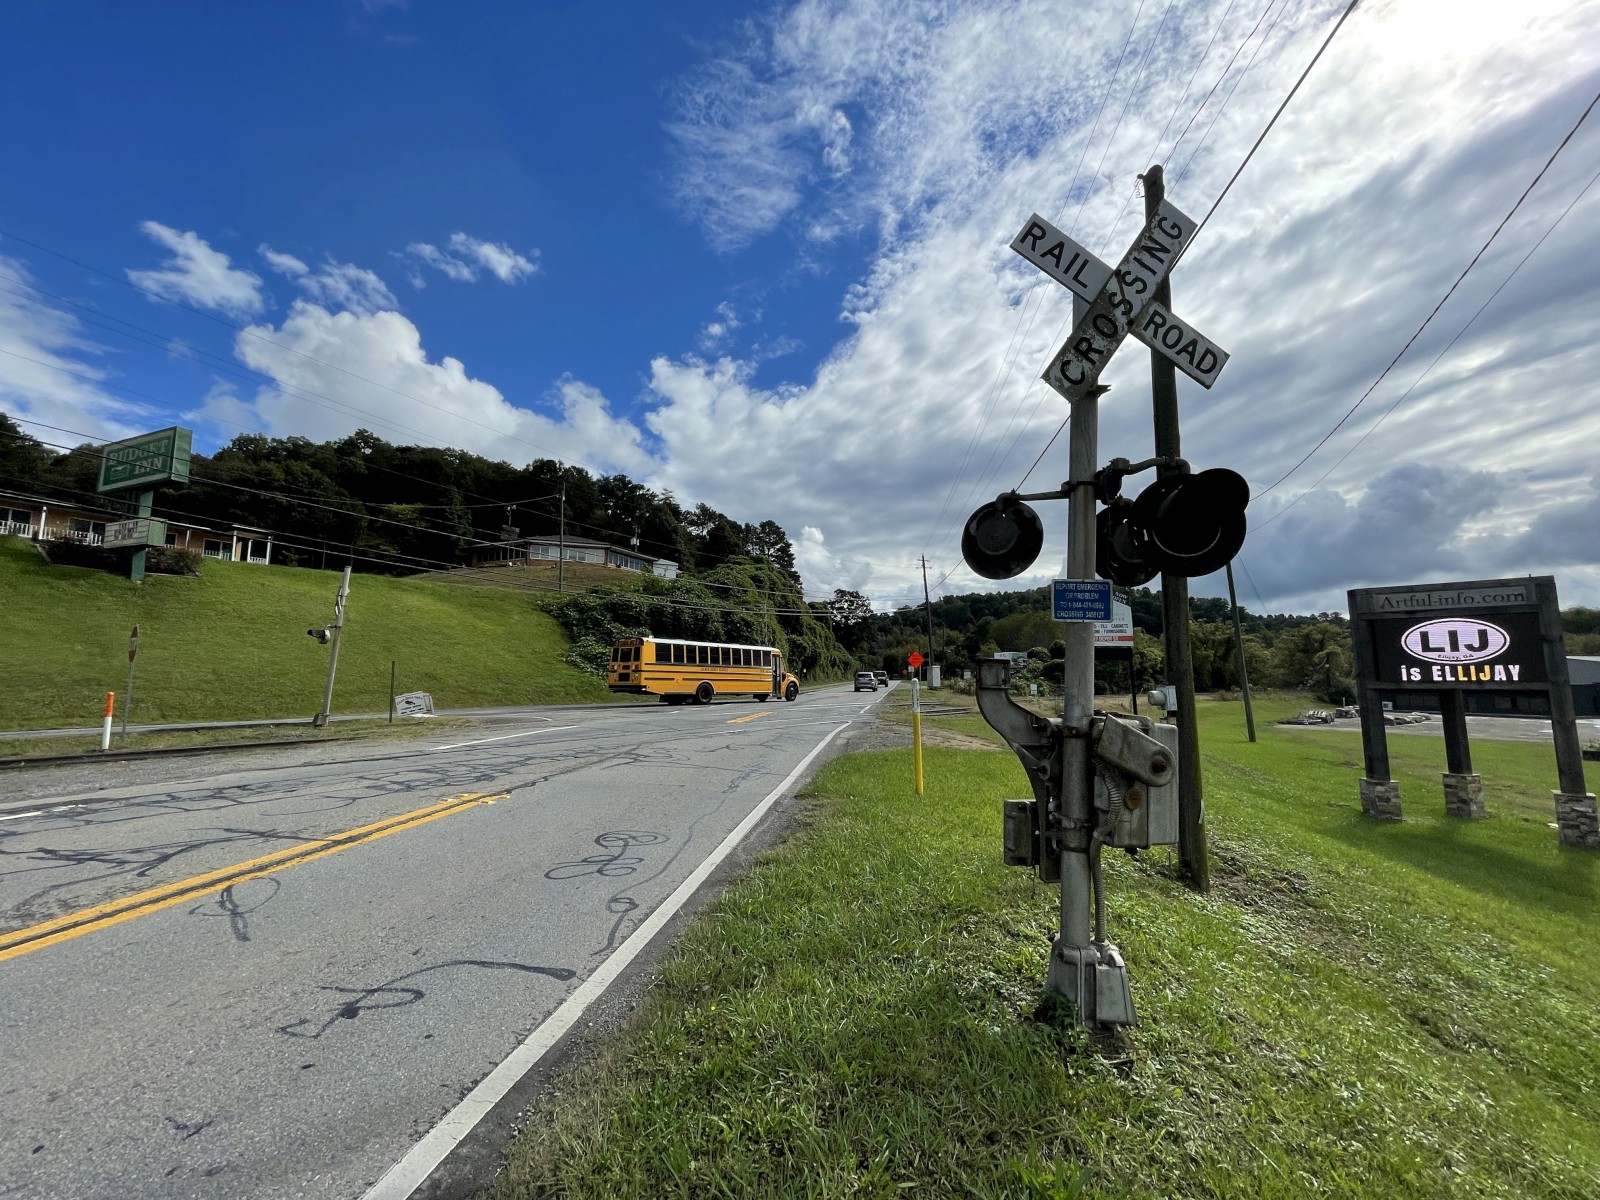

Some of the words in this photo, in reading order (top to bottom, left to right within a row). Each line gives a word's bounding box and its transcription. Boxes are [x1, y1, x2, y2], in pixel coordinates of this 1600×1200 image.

[1019, 221, 1090, 289] RAIL
[1060, 216, 1183, 386] CROSSING
[1143, 309, 1218, 375] ROAD
[1076, 583, 1109, 591] EMERGENCY
[1379, 591, 1526, 610] Artful-info.com
[1056, 610, 1084, 618] CROSSING
[1419, 628, 1490, 653] LIJ
[1400, 665, 1422, 681] is
[1431, 664, 1521, 682] ELLIJAY
